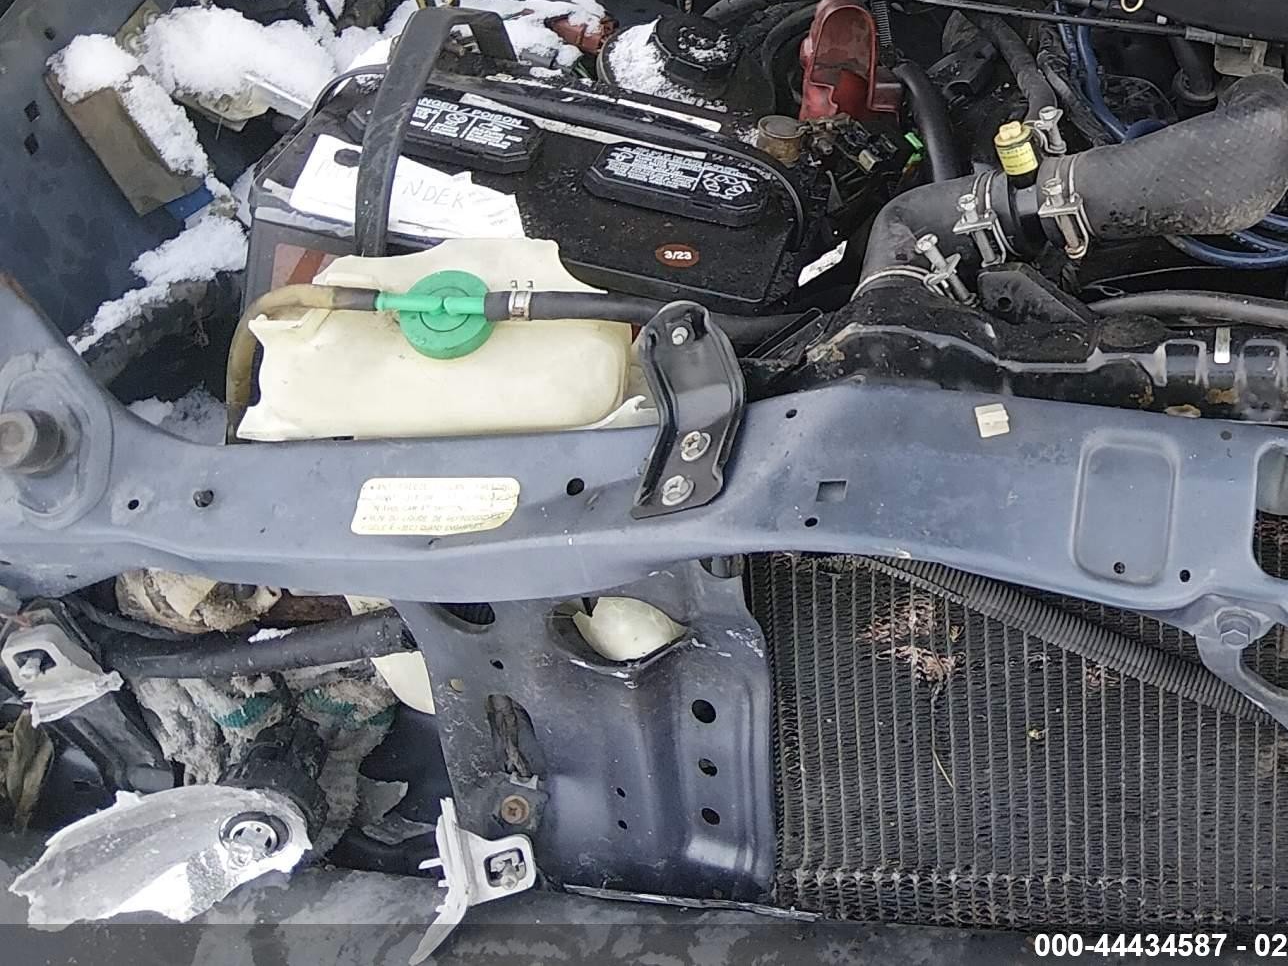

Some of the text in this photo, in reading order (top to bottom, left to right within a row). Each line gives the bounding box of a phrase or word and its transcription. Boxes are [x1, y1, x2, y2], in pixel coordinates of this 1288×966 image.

[417, 97, 460, 111] NGER
[471, 109, 523, 126] POISON
[663, 250, 692, 260] 3/23
